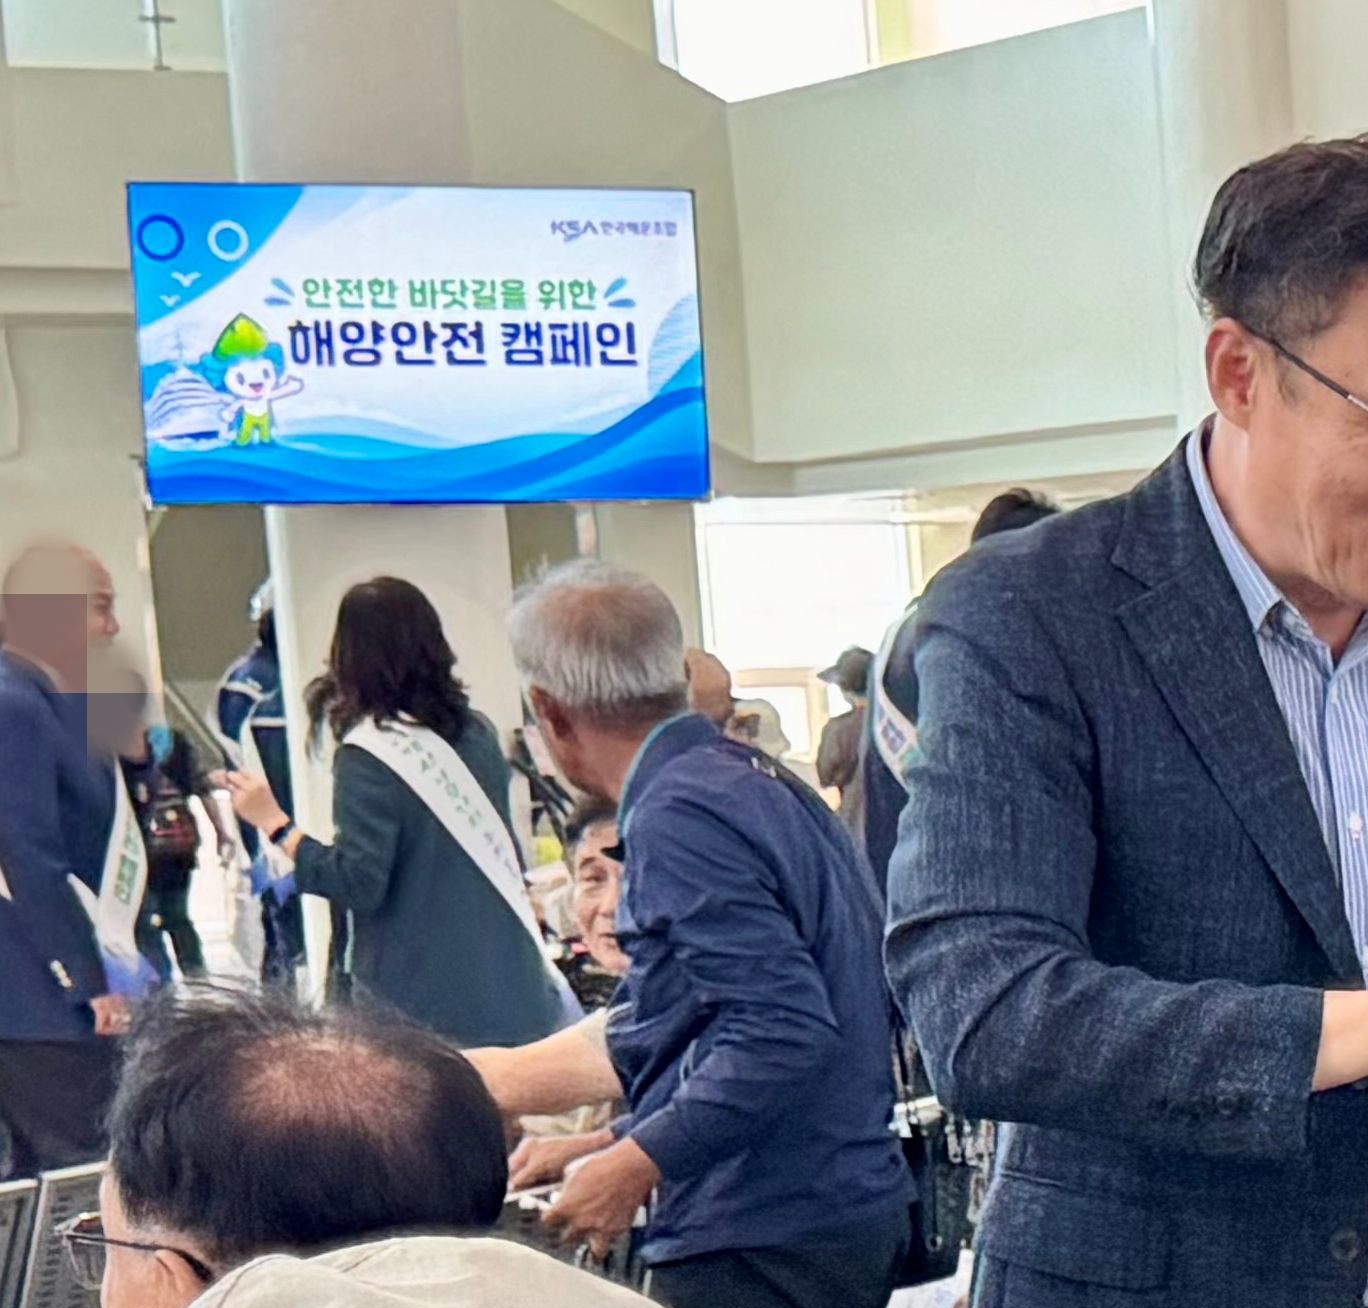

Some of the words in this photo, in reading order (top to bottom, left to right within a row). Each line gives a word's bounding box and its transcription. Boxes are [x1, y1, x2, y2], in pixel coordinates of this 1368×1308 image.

[302, 277, 398, 310] 안전한
[409, 278, 527, 311] 바닷길을
[538, 279, 597, 311] 위한
[289, 319, 487, 368] 해양안전
[501, 320, 639, 368] 캠페인
